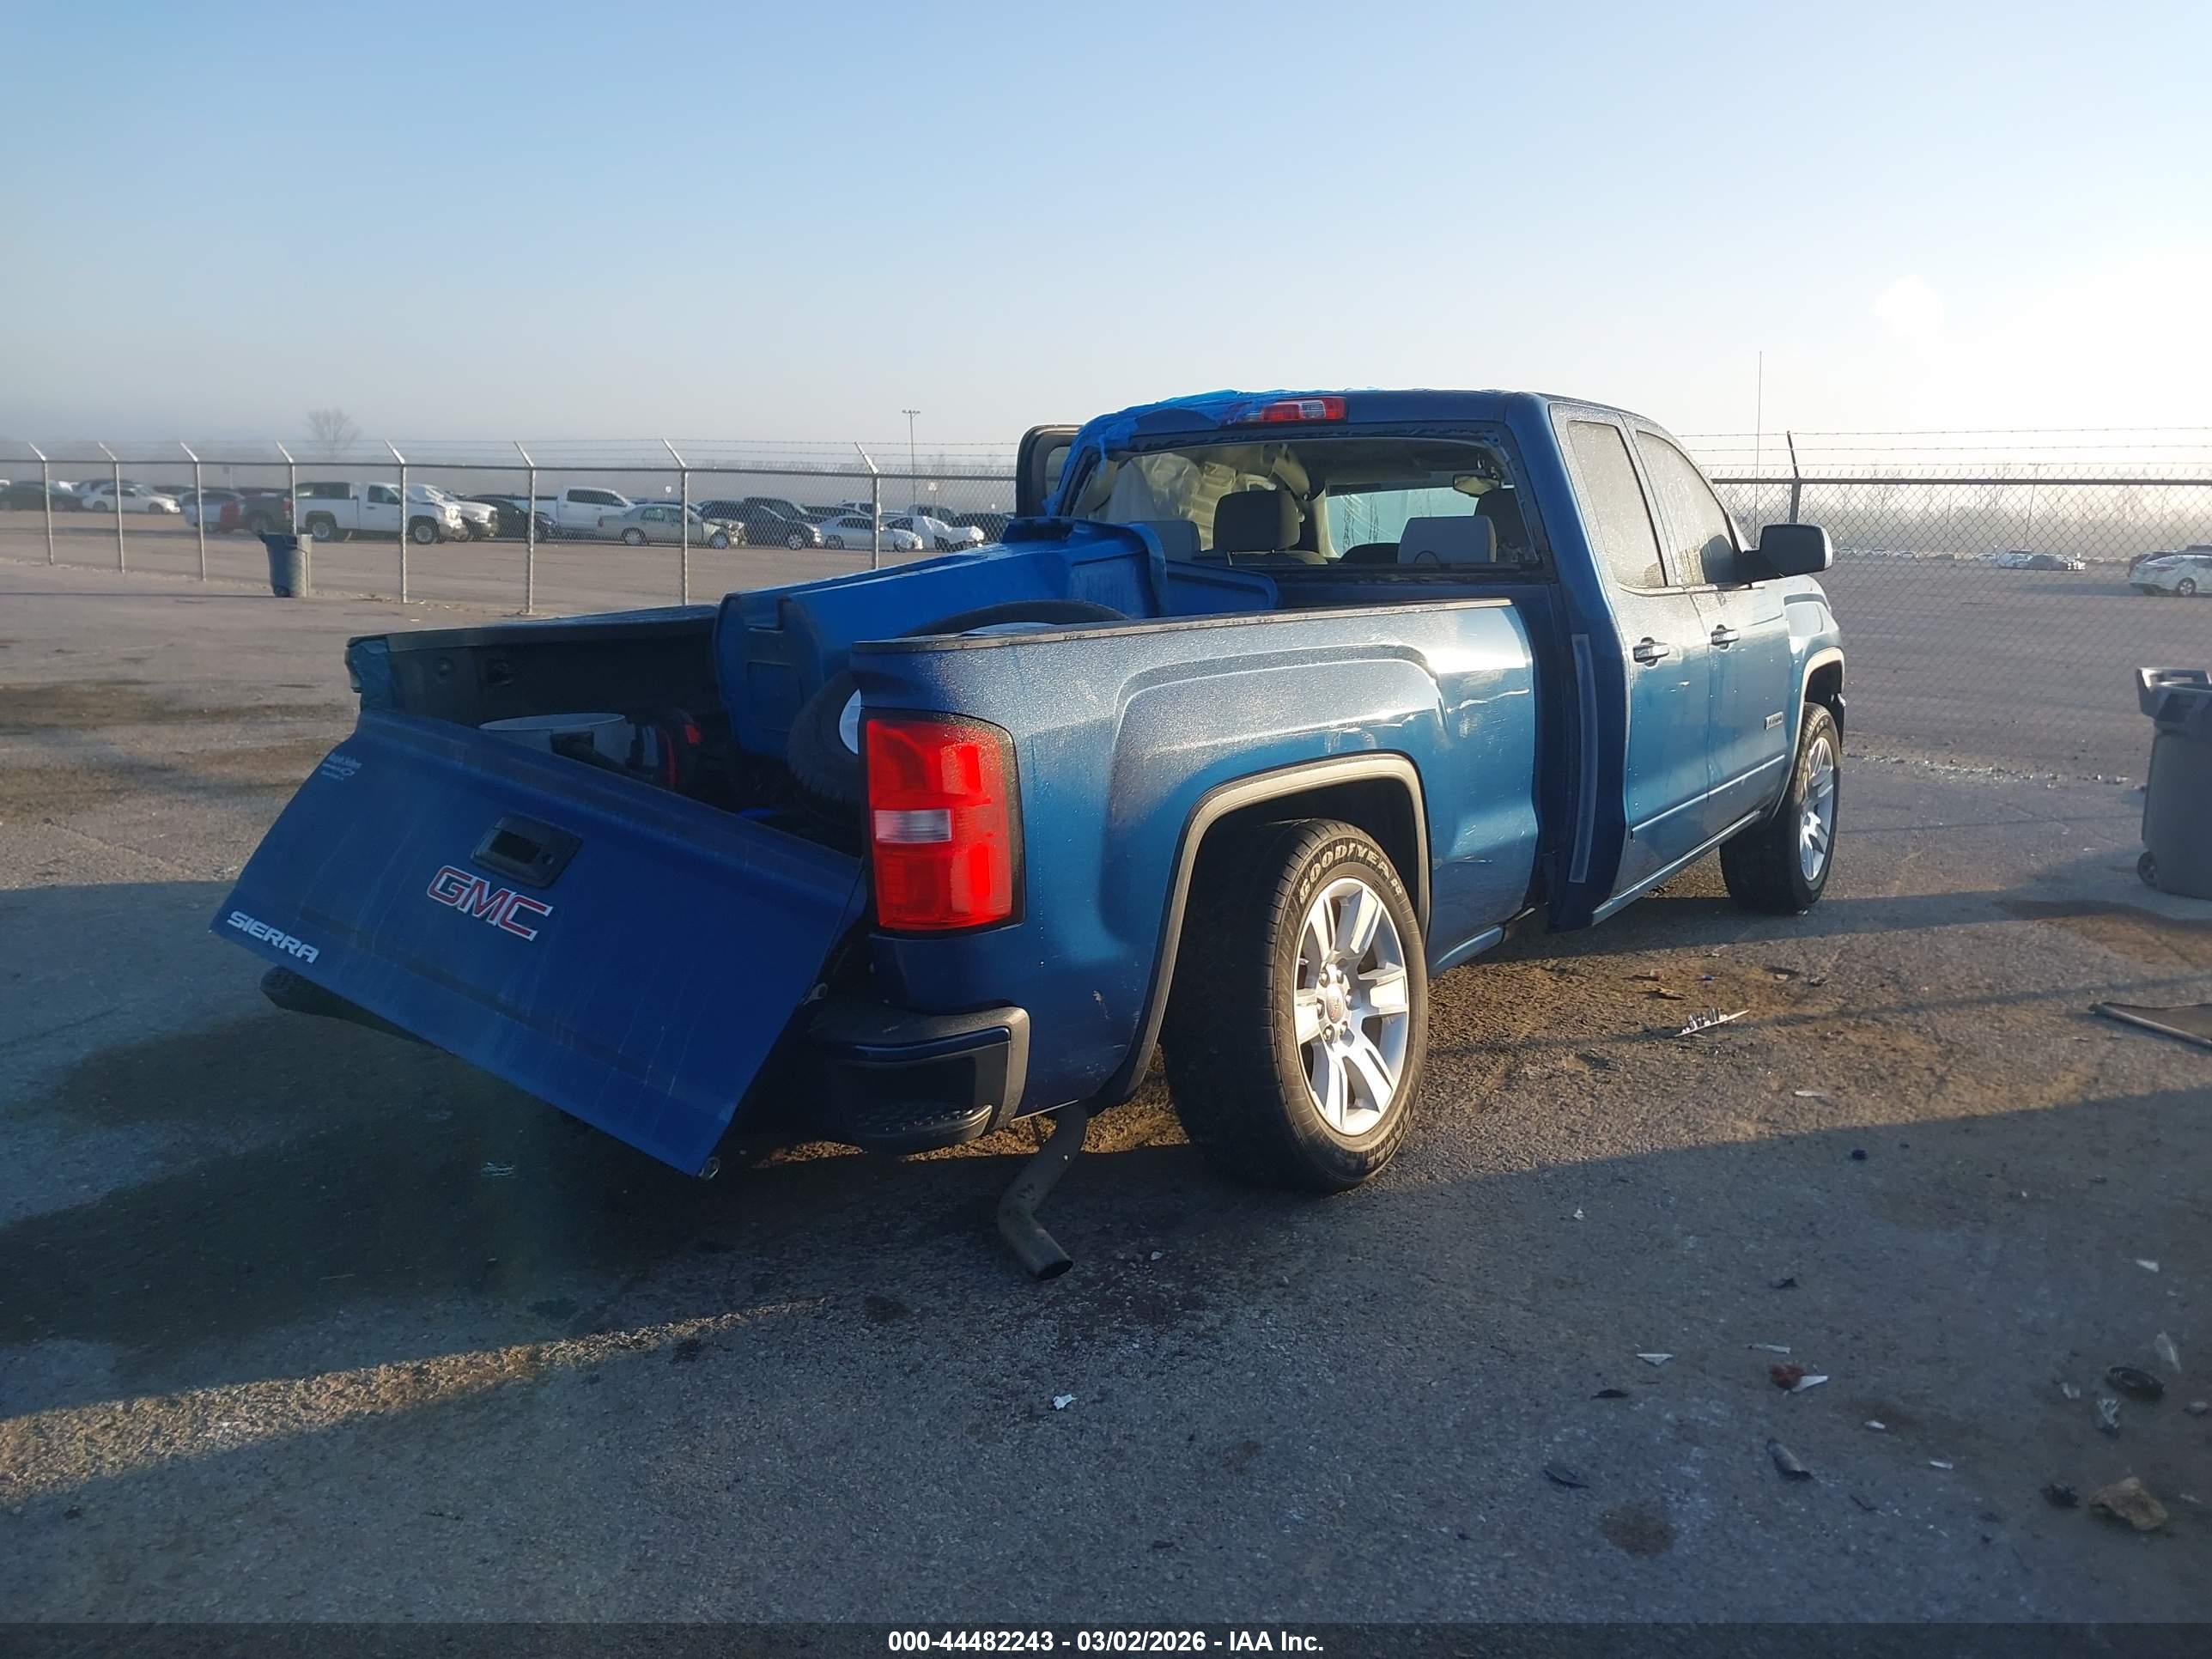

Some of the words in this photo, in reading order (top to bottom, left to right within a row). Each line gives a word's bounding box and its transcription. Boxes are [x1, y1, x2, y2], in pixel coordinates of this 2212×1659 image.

[427, 865, 554, 942] GMC
[1299, 842, 1403, 904] GOODYEAR
[226, 910, 320, 964] SIERRA
